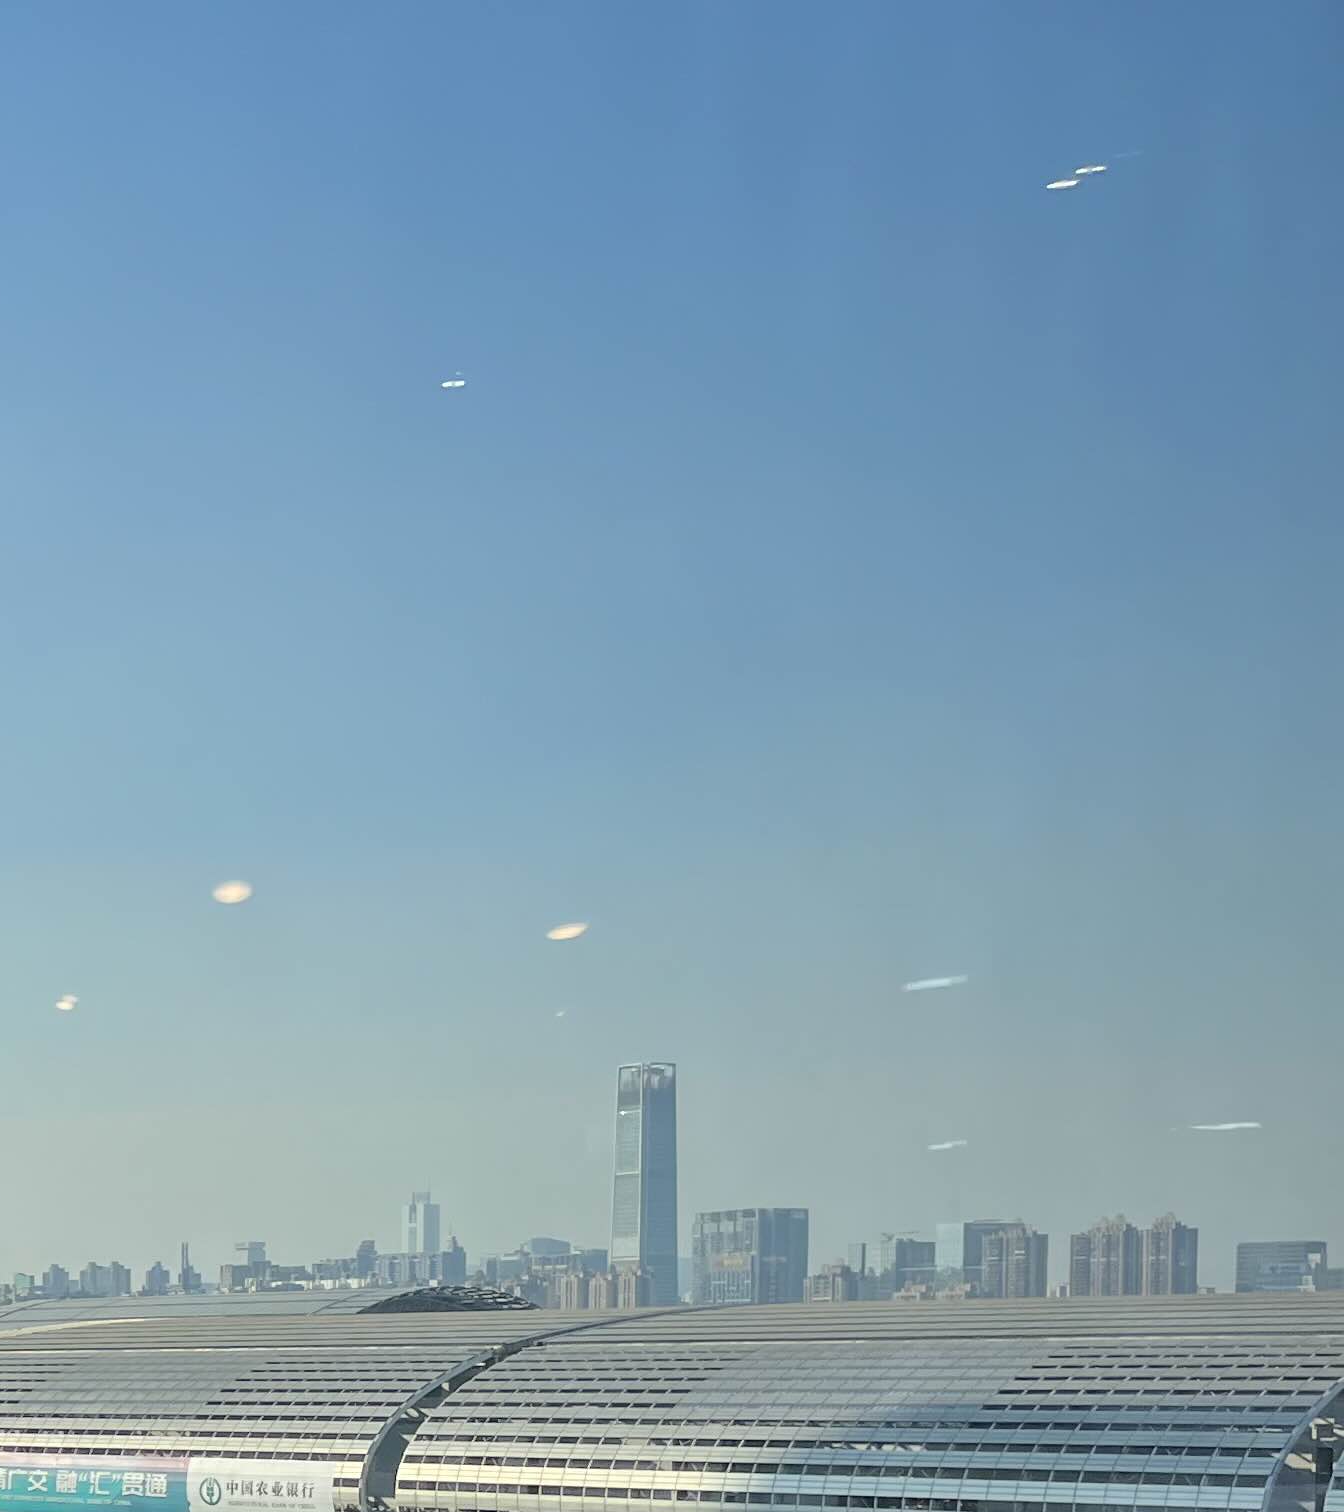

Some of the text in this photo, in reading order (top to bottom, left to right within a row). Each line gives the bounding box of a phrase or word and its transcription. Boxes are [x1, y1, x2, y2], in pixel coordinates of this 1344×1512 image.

[225, 1479, 316, 1499] 中国农业银行
